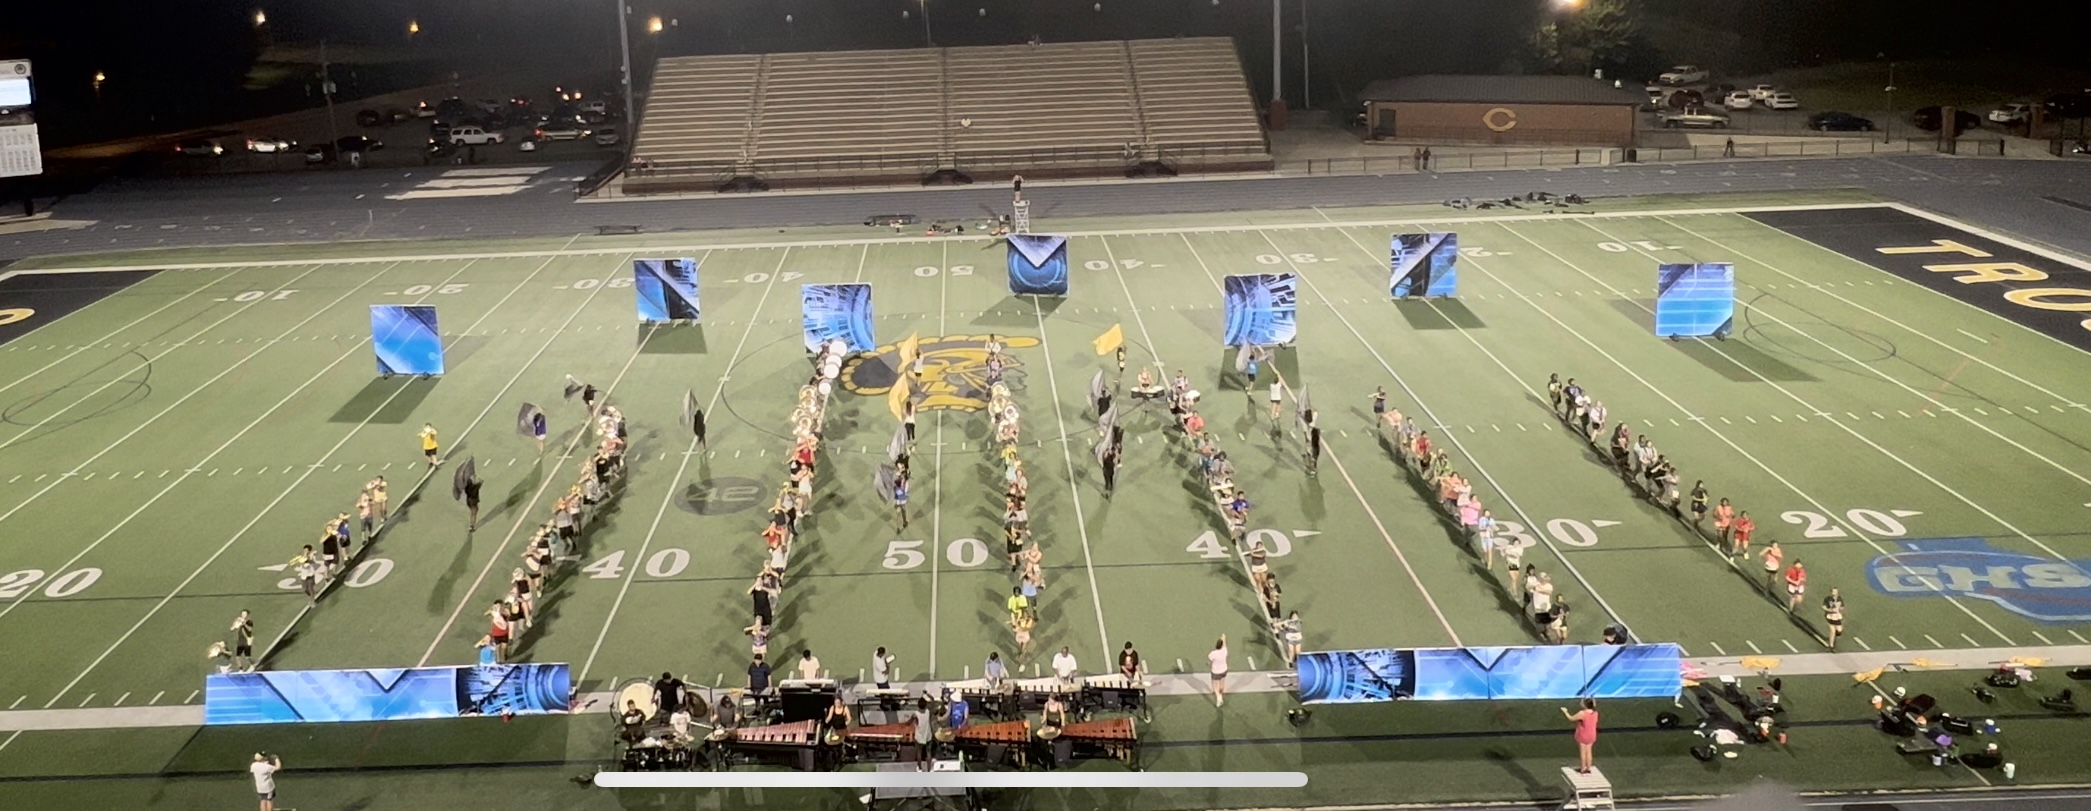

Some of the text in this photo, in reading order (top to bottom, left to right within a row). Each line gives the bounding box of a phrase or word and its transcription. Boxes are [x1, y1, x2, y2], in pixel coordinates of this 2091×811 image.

[1597, 240, 1664, 253] 10
[1084, 259, 1144, 271] 40
[1256, 254, 1318, 264] 30
[744, 271, 804, 284] 40
[914, 265, 974, 277] 50
[403, 284, 470, 295] 20
[1875, 239, 2091, 332] TRO
[233, 290, 299, 302] 10
[686, 486, 760, 503] 42
[1780, 509, 1908, 539] 20
[1185, 528, 1292, 559] 40
[882, 538, 989, 570] 50
[582, 548, 691, 579] 40
[0, 567, 103, 598] 20
